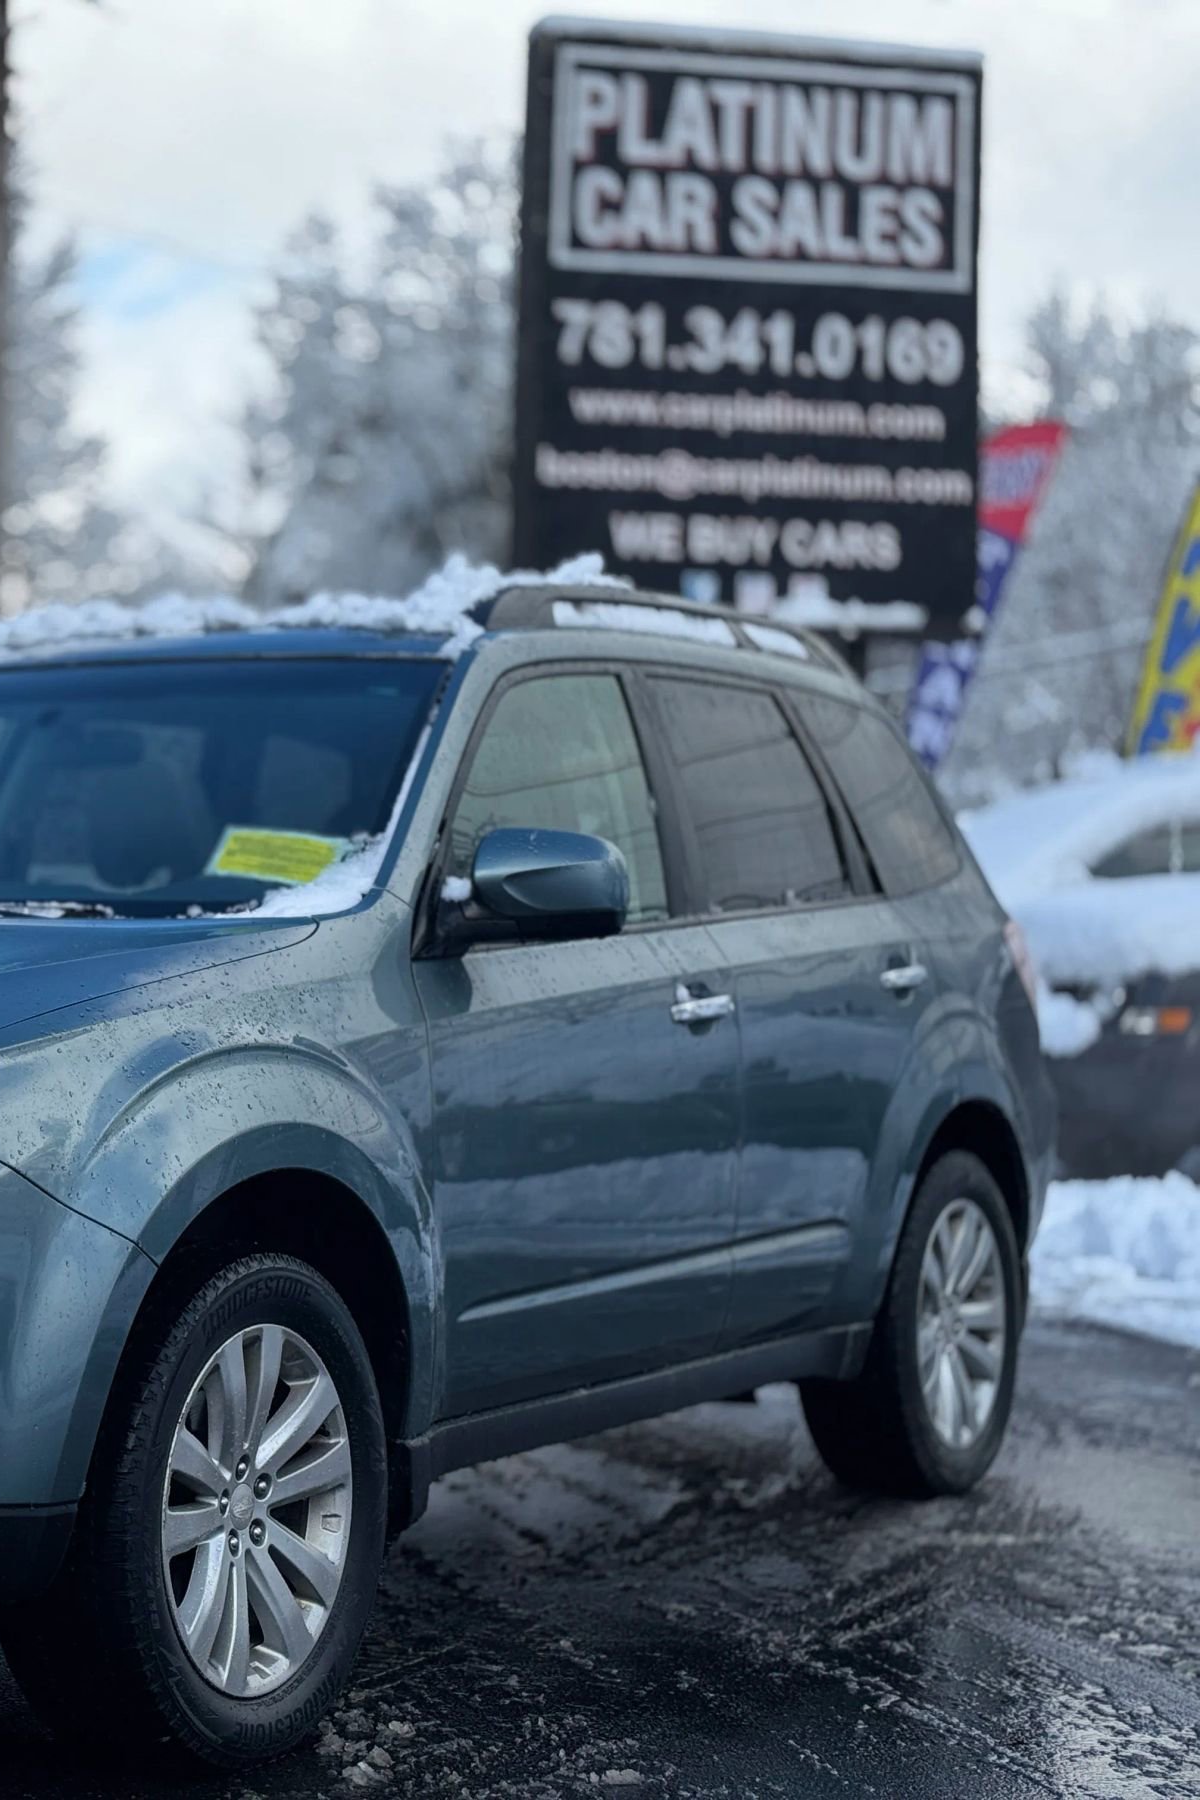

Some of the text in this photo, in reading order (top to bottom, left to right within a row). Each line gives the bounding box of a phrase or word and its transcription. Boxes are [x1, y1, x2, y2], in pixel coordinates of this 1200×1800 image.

[575, 70, 956, 186] PLATINUM
[573, 165, 946, 267] CAR SALES
[552, 298, 965, 386] 781.341.0169
[569, 388, 945, 440] www.carplatinum.com
[609, 511, 901, 571] WE BUY CARS
